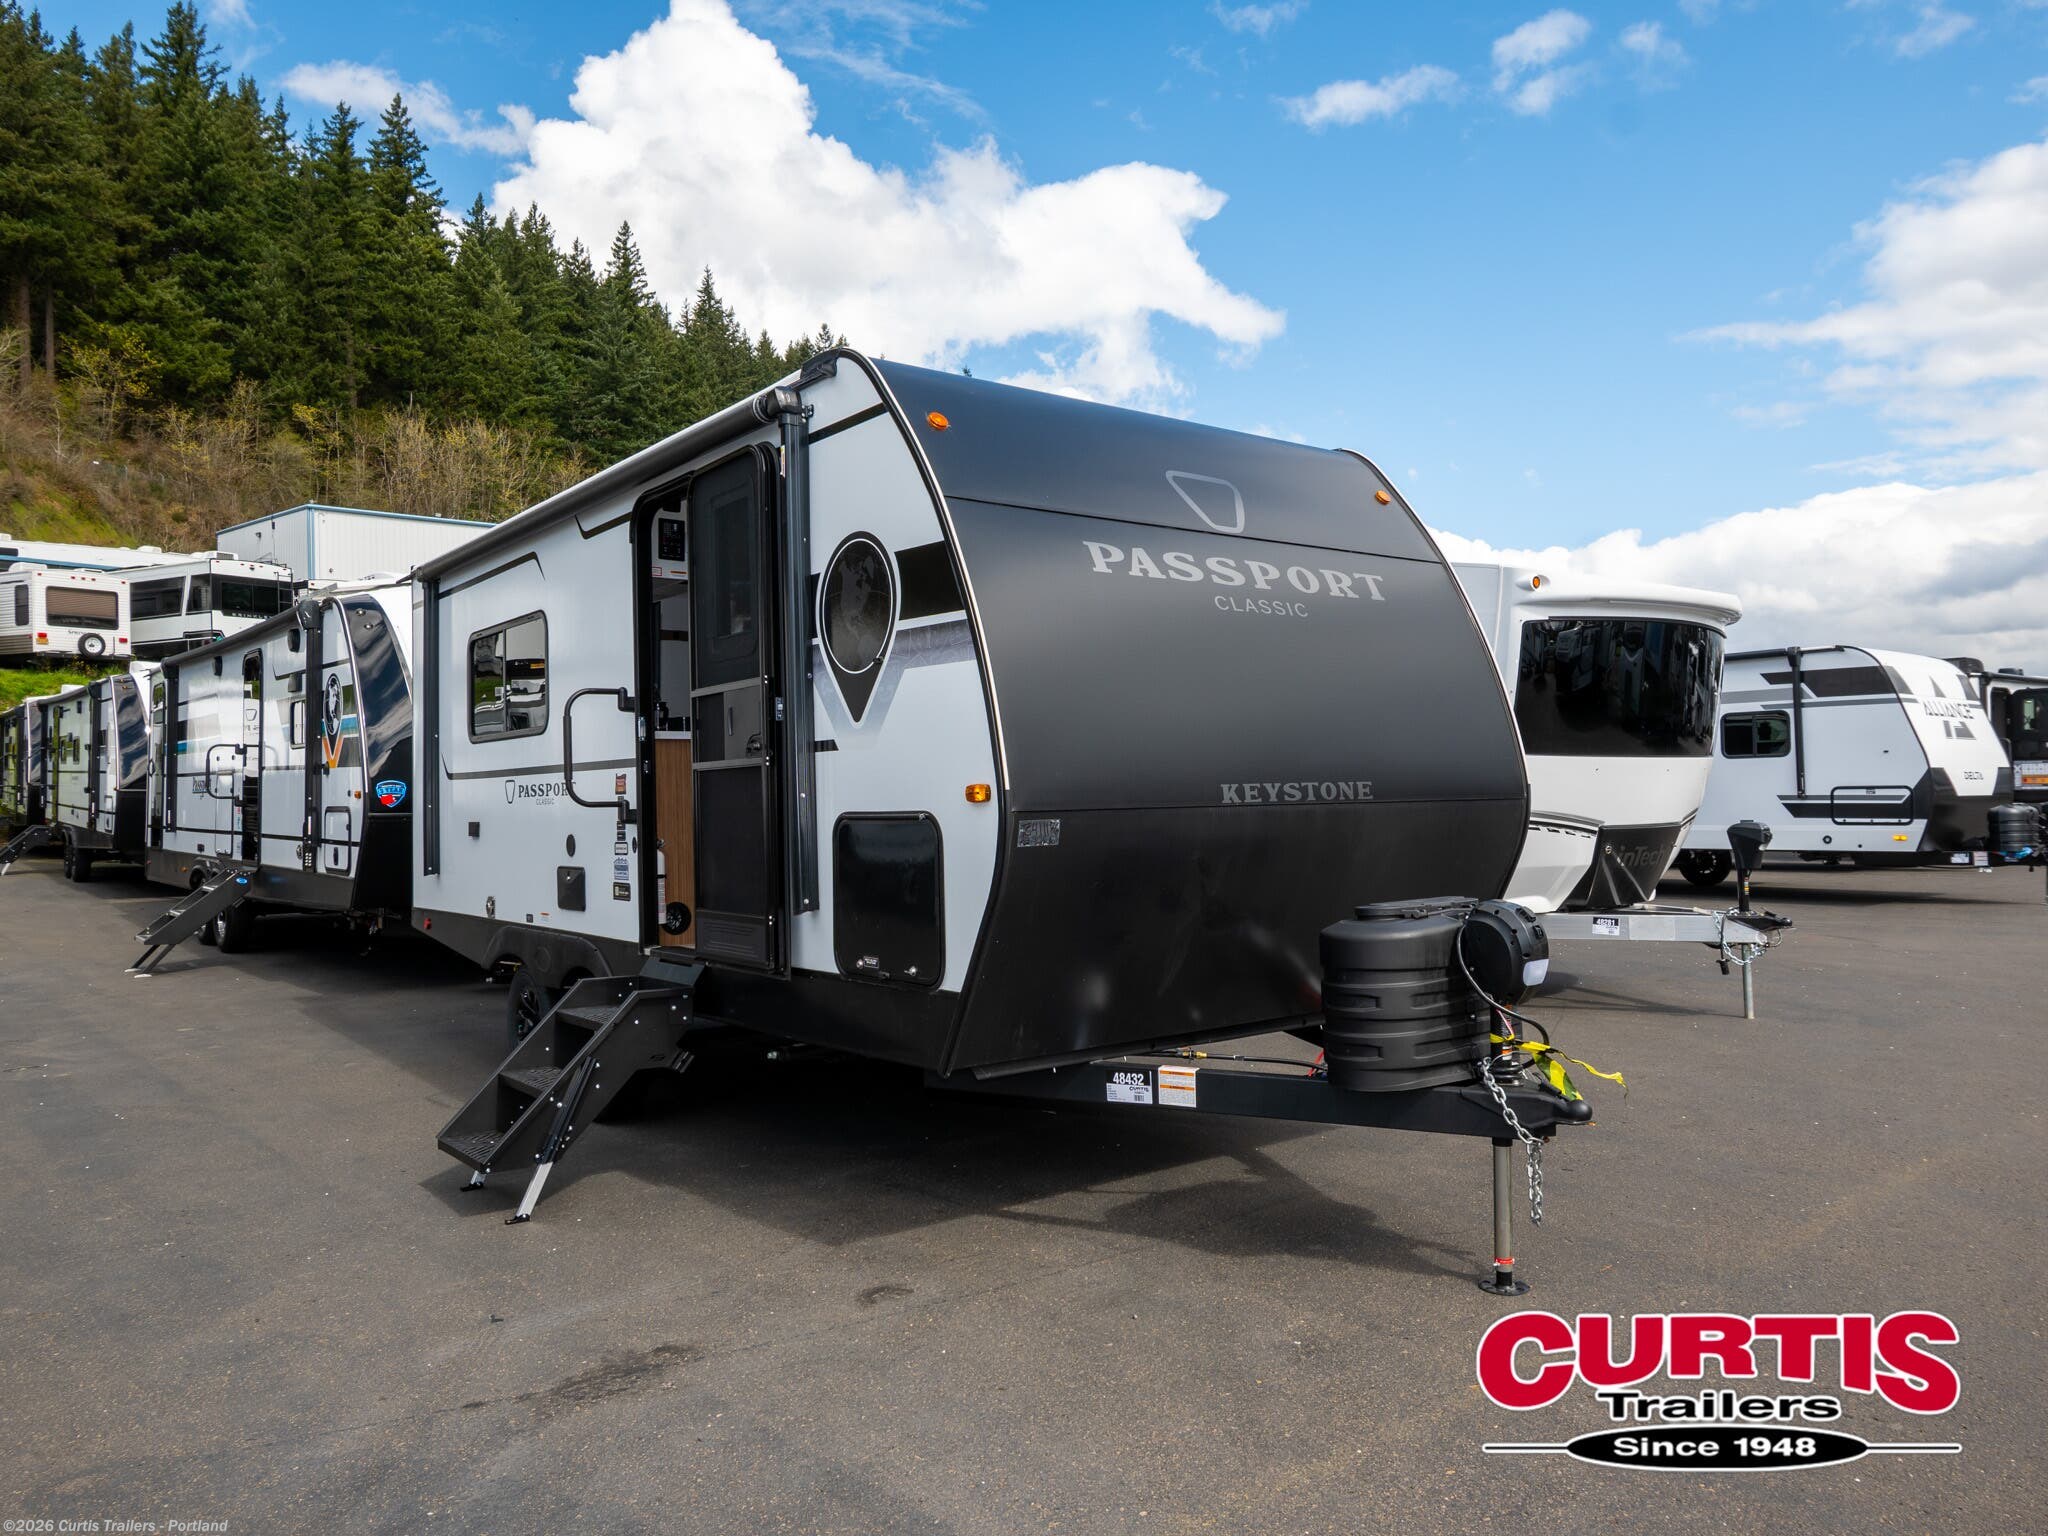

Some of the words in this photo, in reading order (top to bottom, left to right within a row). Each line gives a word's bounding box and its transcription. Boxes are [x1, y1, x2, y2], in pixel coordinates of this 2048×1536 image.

[1082, 540, 1386, 601] PASSPORT
[1214, 595, 1309, 617] CLASSIC
[1922, 701, 1975, 719] ALLIANCE
[518, 782, 577, 798] PASSPOR
[1220, 781, 1374, 803] KEYSTONE
[1113, 1072, 1144, 1086] 48432
